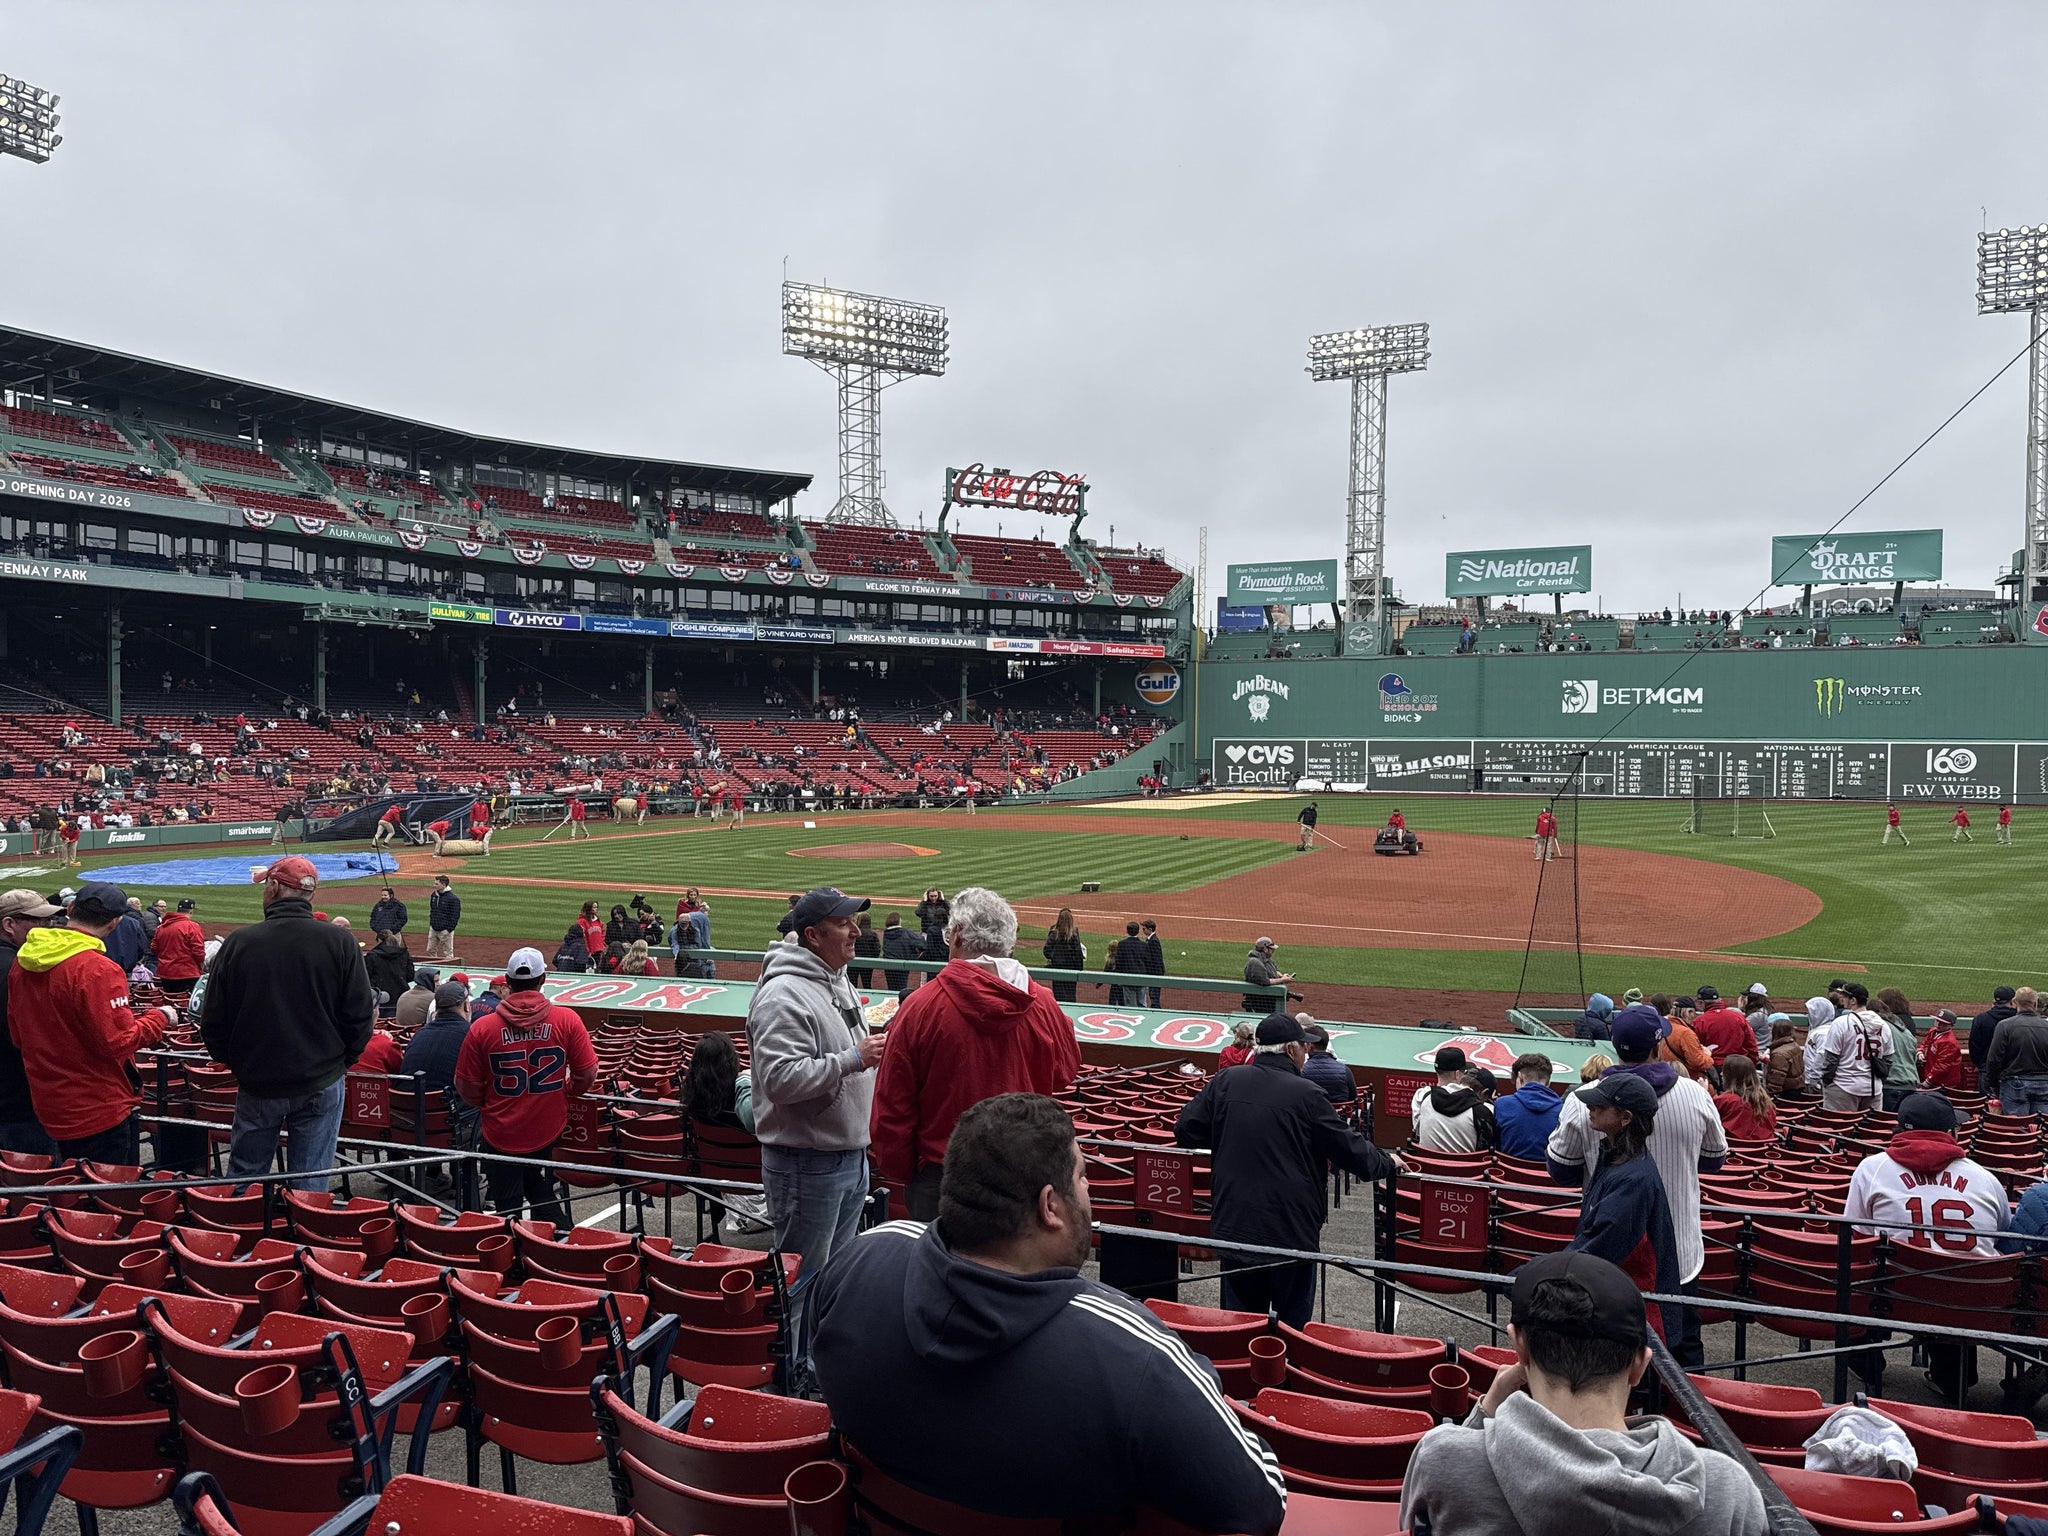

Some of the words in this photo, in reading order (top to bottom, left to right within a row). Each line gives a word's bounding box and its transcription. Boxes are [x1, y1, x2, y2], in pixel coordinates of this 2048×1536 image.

[11, 481, 65, 498] OPENING
[69, 490, 94, 502] DAY
[100, 494, 131, 508] 2026
[357, 530, 393, 546] PAVILION
[1485, 556, 1579, 579] National
[1811, 551, 1897, 570] DRAFT
[54, 568, 88, 581] PARK
[1822, 565, 1894, 580] KINGS
[1239, 575, 1292, 589] Plymouth
[1295, 572, 1325, 586] Rock
[1516, 578, 1534, 587] Car
[1538, 577, 1573, 586] Rental
[865, 582, 899, 592] WELCOME
[912, 585, 940, 595] FENWAY
[942, 588, 960, 596] PARK
[431, 607, 465, 619] SULLIVAN
[475, 612, 490, 621] TIRE
[526, 615, 564, 626] HYCU
[672, 623, 709, 632] COGHLIN
[708, 625, 753, 634] COMPANIES
[766, 630, 806, 638] VINEYARD
[807, 632, 831, 640] VINES
[848, 634, 885, 643] AMERICA'S
[887, 635, 906, 643] MOST
[909, 637, 940, 645] BELOVED
[941, 638, 976, 647] BALLPARK
[1106, 646, 1134, 654] Safelite
[1136, 675, 1177, 689] Gulf
[1232, 680, 1255, 701] JIM
[1256, 674, 1290, 701] BEAM
[1848, 684, 1922, 697] MONSTER
[1385, 695, 1410, 704] RED
[1412, 695, 1438, 704] SOX
[1384, 714, 1412, 722] BIDMC
[1247, 744, 1294, 764] CVS
[1370, 755, 1386, 763] WHO
[1386, 754, 1399, 762] BUT
[1926, 747, 1977, 774] 160
[1405, 755, 1470, 772] MASON
[1227, 766, 1290, 783] Health
[1941, 784, 2001, 799] WEBB
[228, 826, 272, 836] smartwater
[110, 996, 128, 1008] HH
[501, 1023, 552, 1046] ABREU
[489, 1046, 566, 1097] 52
[356, 1082, 380, 1091] FIELD
[358, 1103, 382, 1119] 24
[561, 1126, 588, 1142] 23
[1146, 1158, 1181, 1169] FIELD
[1151, 1170, 1176, 1180] BOX
[1900, 1171, 1968, 1193] DURAN
[1147, 1184, 1181, 1204] 22
[1435, 1190, 1474, 1202] FIELD
[1440, 1202, 1468, 1214] BOX
[1439, 1218, 1466, 1239] 21
[1905, 1197, 1977, 1251] 16
[346, 1377, 359, 1400] CC
